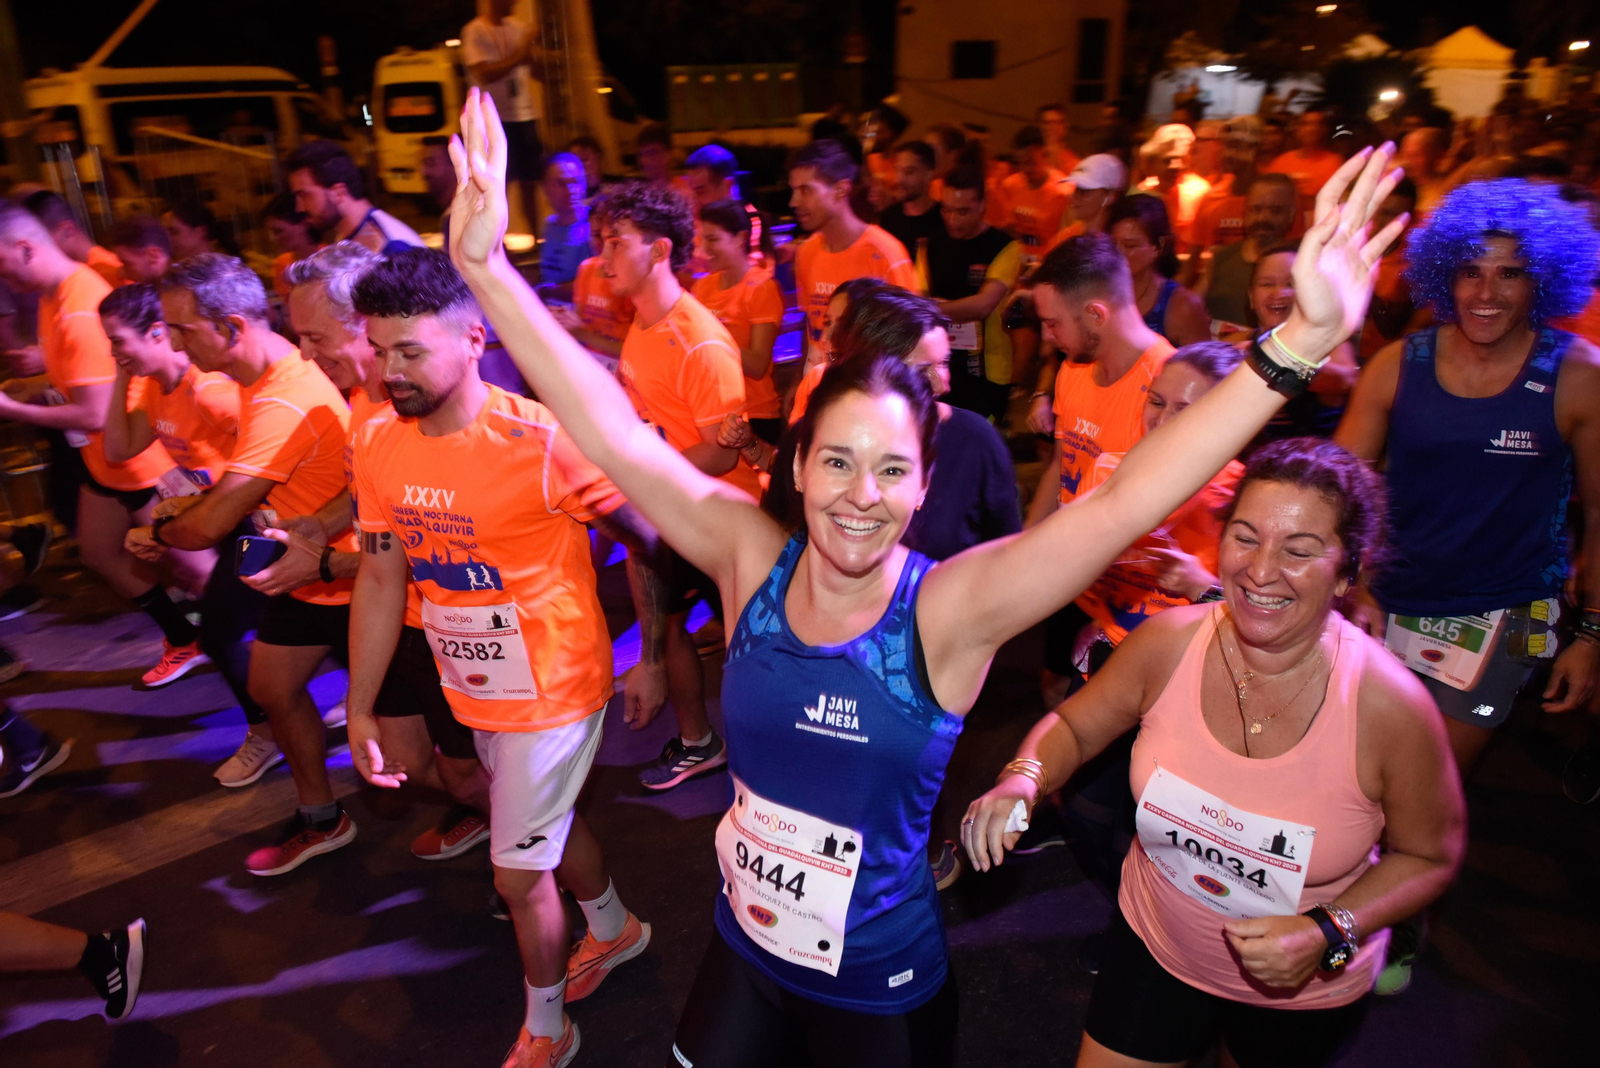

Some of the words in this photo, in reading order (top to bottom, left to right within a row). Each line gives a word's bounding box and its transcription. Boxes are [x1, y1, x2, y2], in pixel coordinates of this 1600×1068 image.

[1506, 440, 1533, 449] MESA
[1508, 430, 1531, 440] JAVI
[402, 484, 455, 510] XXXV
[422, 510, 474, 525] NOCTURNA
[1418, 616, 1462, 642] 645
[437, 637, 506, 661] 22582
[827, 696, 858, 715] JAVI
[795, 722, 837, 738] ENTRENAMIENTOS
[836, 732, 870, 743] PERSONALES
[825, 711, 860, 731] MESA
[1146, 803, 1162, 815] XXXV
[1161, 811, 1186, 826] CARRERA
[1185, 822, 1216, 840] NOCTURNA
[1215, 836, 1226, 846] DEL
[1225, 842, 1270, 862] GUADALQUIVIR
[1269, 858, 1283, 867] KH7
[1282, 861, 1298, 871] 2023
[778, 847, 821, 867] GUADALQUIVIR
[820, 860, 834, 871] KH7
[832, 865, 848, 875] 2023
[1165, 830, 1268, 889] 10034
[736, 841, 807, 902] 9444
[1207, 863, 1216, 872] LA
[1216, 868, 1243, 886] FUENTE
[1198, 876, 1224, 894] KH7
[734, 872, 748, 887] MESA
[781, 902, 792, 913] DE
[791, 907, 823, 923] CASTRO
[749, 906, 773, 925] KH7
